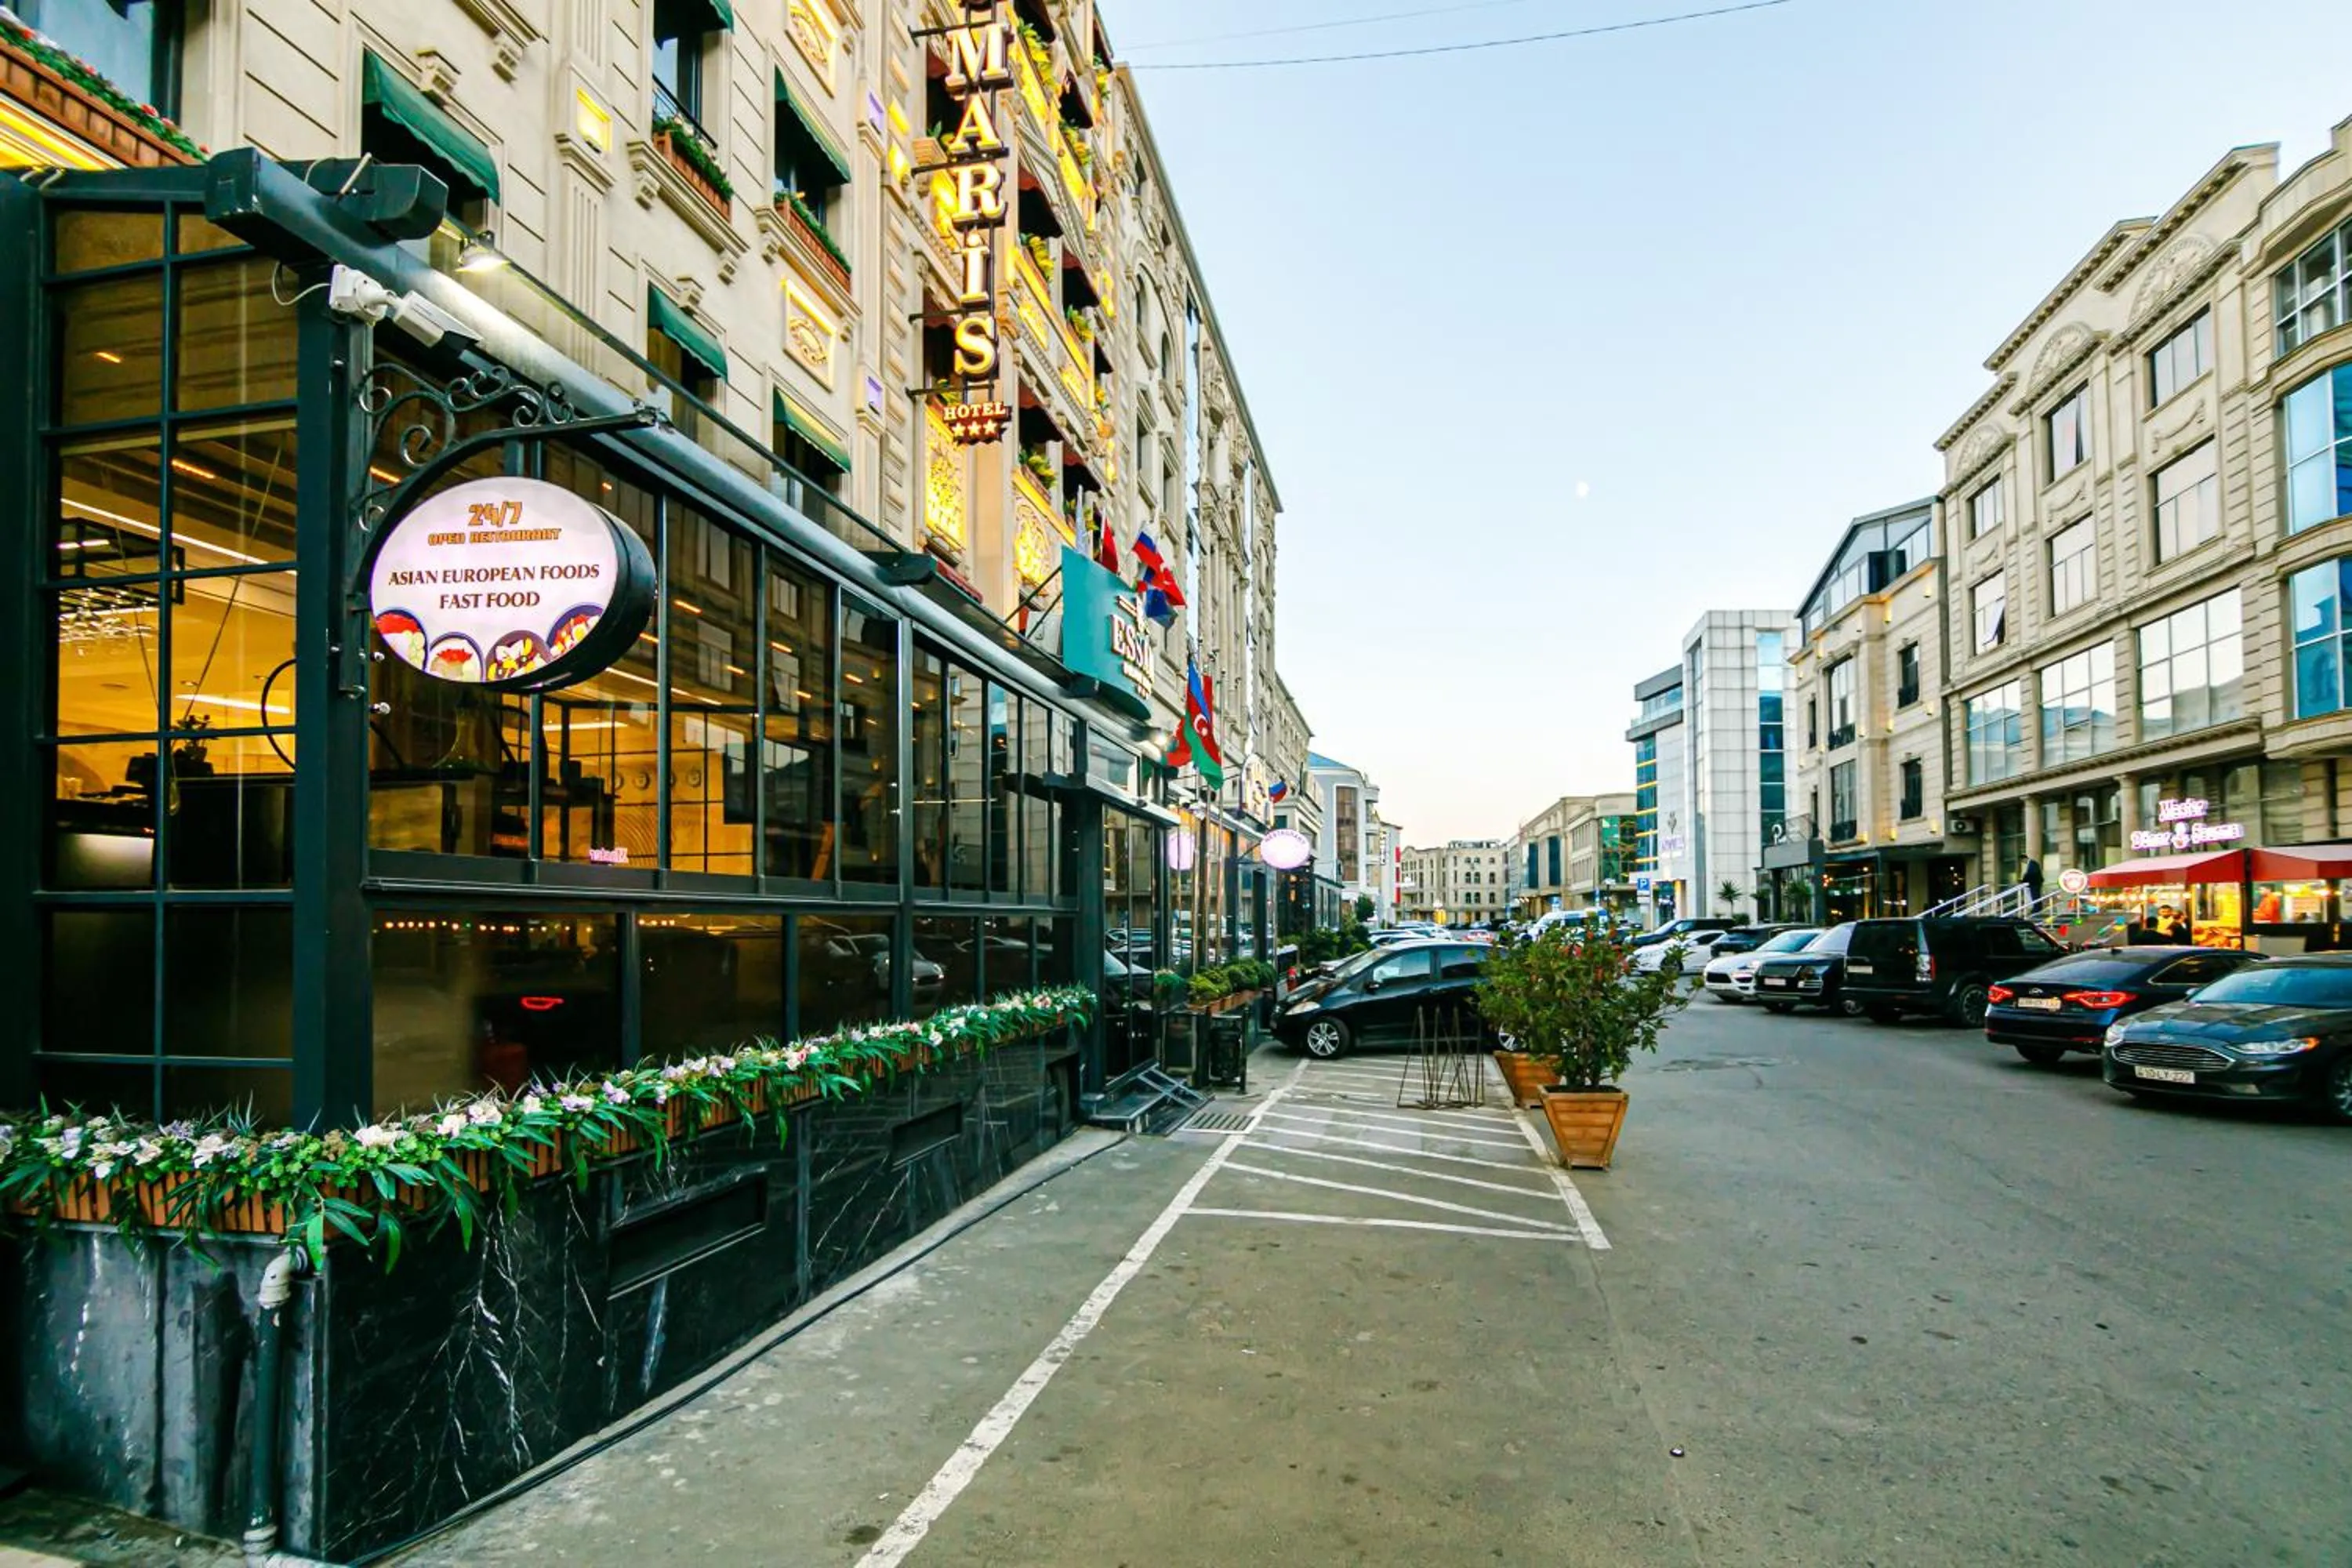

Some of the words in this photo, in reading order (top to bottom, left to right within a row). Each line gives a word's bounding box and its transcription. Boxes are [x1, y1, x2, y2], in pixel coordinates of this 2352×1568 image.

[943, 401, 1007, 421] HOTEL
[468, 501, 523, 528] 24/7
[389, 570, 438, 586] ASIAN
[442, 567, 535, 584] EUROPEAN
[540, 564, 600, 579] FOODS
[440, 593, 482, 609] FAST
[486, 591, 540, 608] FOOD
